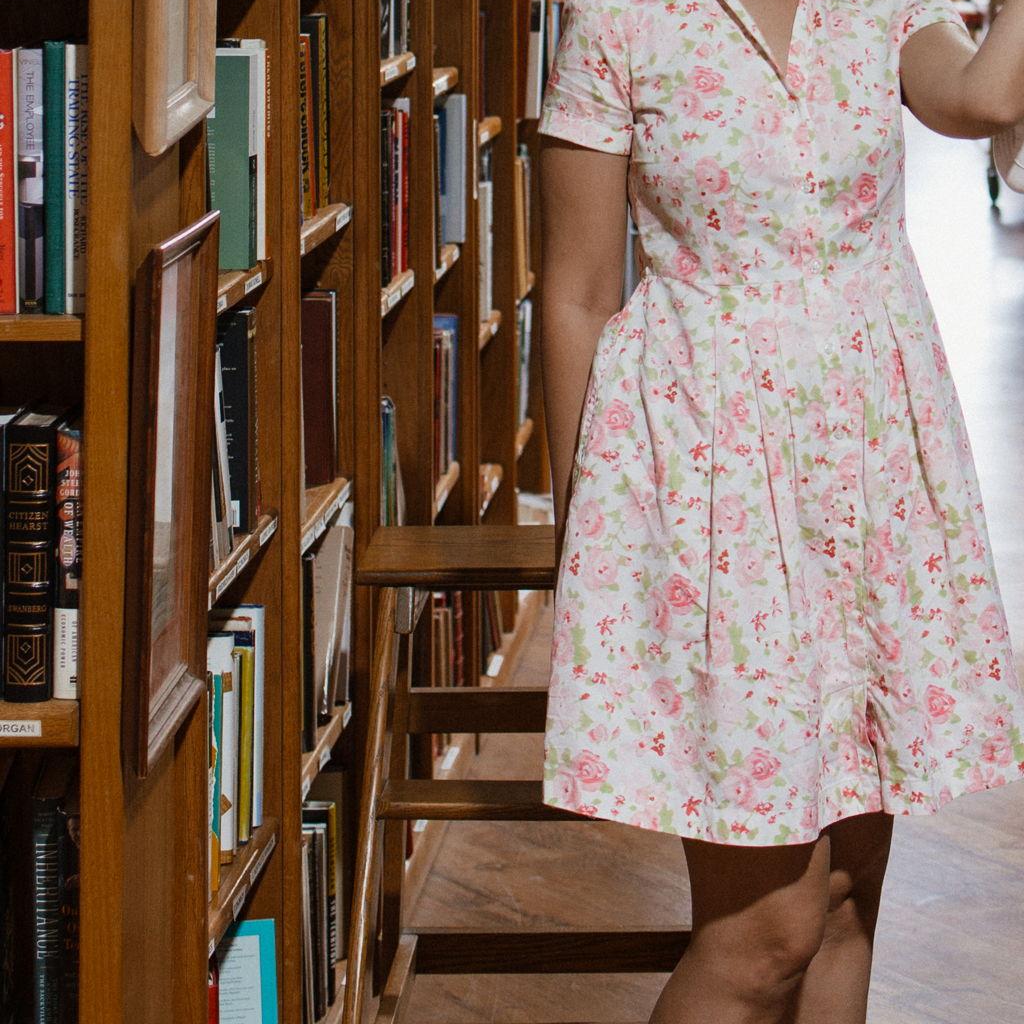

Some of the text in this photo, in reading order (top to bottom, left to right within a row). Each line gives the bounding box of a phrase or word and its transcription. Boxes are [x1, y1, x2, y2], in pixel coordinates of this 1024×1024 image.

[25, 72, 35, 150] THE EMPLOYEE
[68, 79, 79, 200] TRADING STATE
[8, 512, 49, 521] CITIZEN
[8, 521, 48, 531] HEARST
[62, 502, 75, 564] OF WEALTH
[35, 842, 59, 960] INHERITANCE
